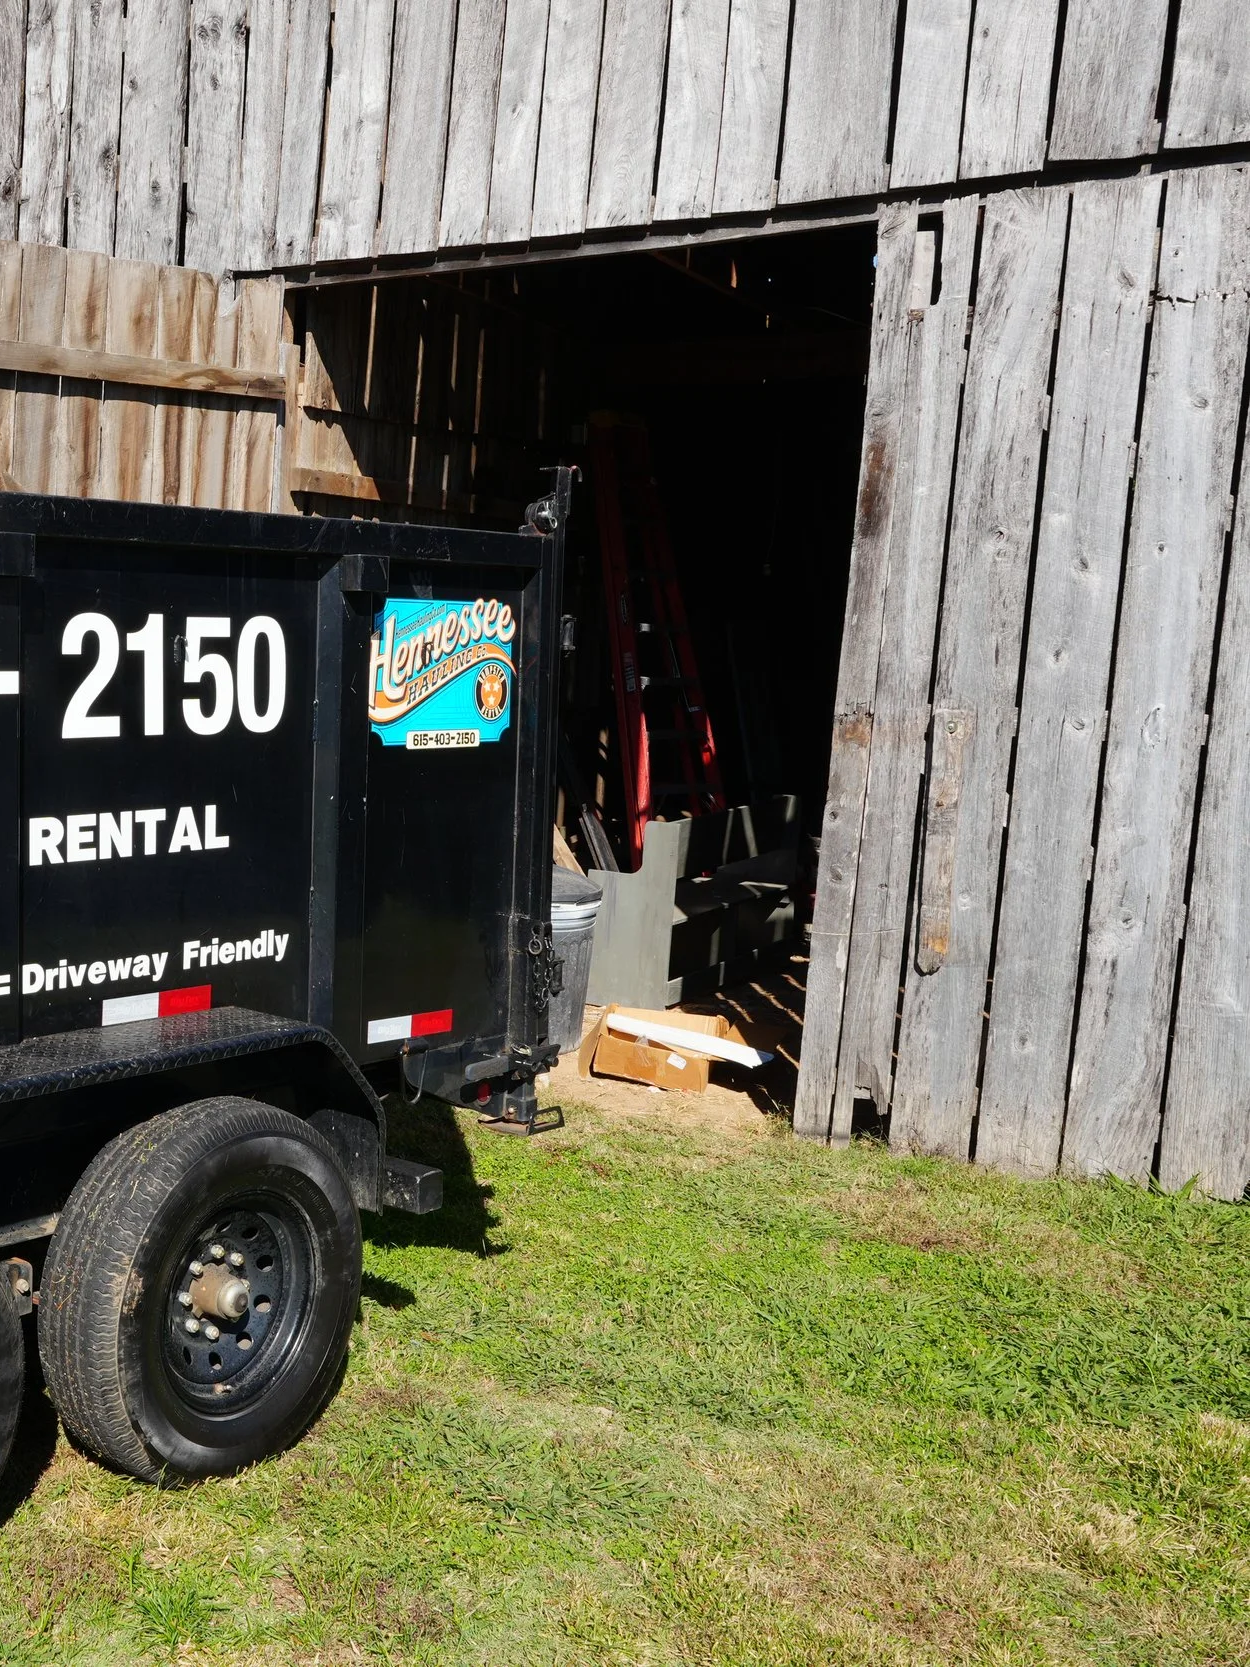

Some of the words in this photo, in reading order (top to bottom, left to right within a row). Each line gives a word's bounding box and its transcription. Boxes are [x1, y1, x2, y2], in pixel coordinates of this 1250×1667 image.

[61, 613, 287, 740] 2150
[368, 598, 516, 711] Hennessee
[407, 648, 473, 707] HAULING
[413, 731, 476, 747] 615-403-2150
[29, 805, 230, 866] RENTAL
[22, 952, 169, 995] Driveway
[183, 930, 290, 972] Friendly
